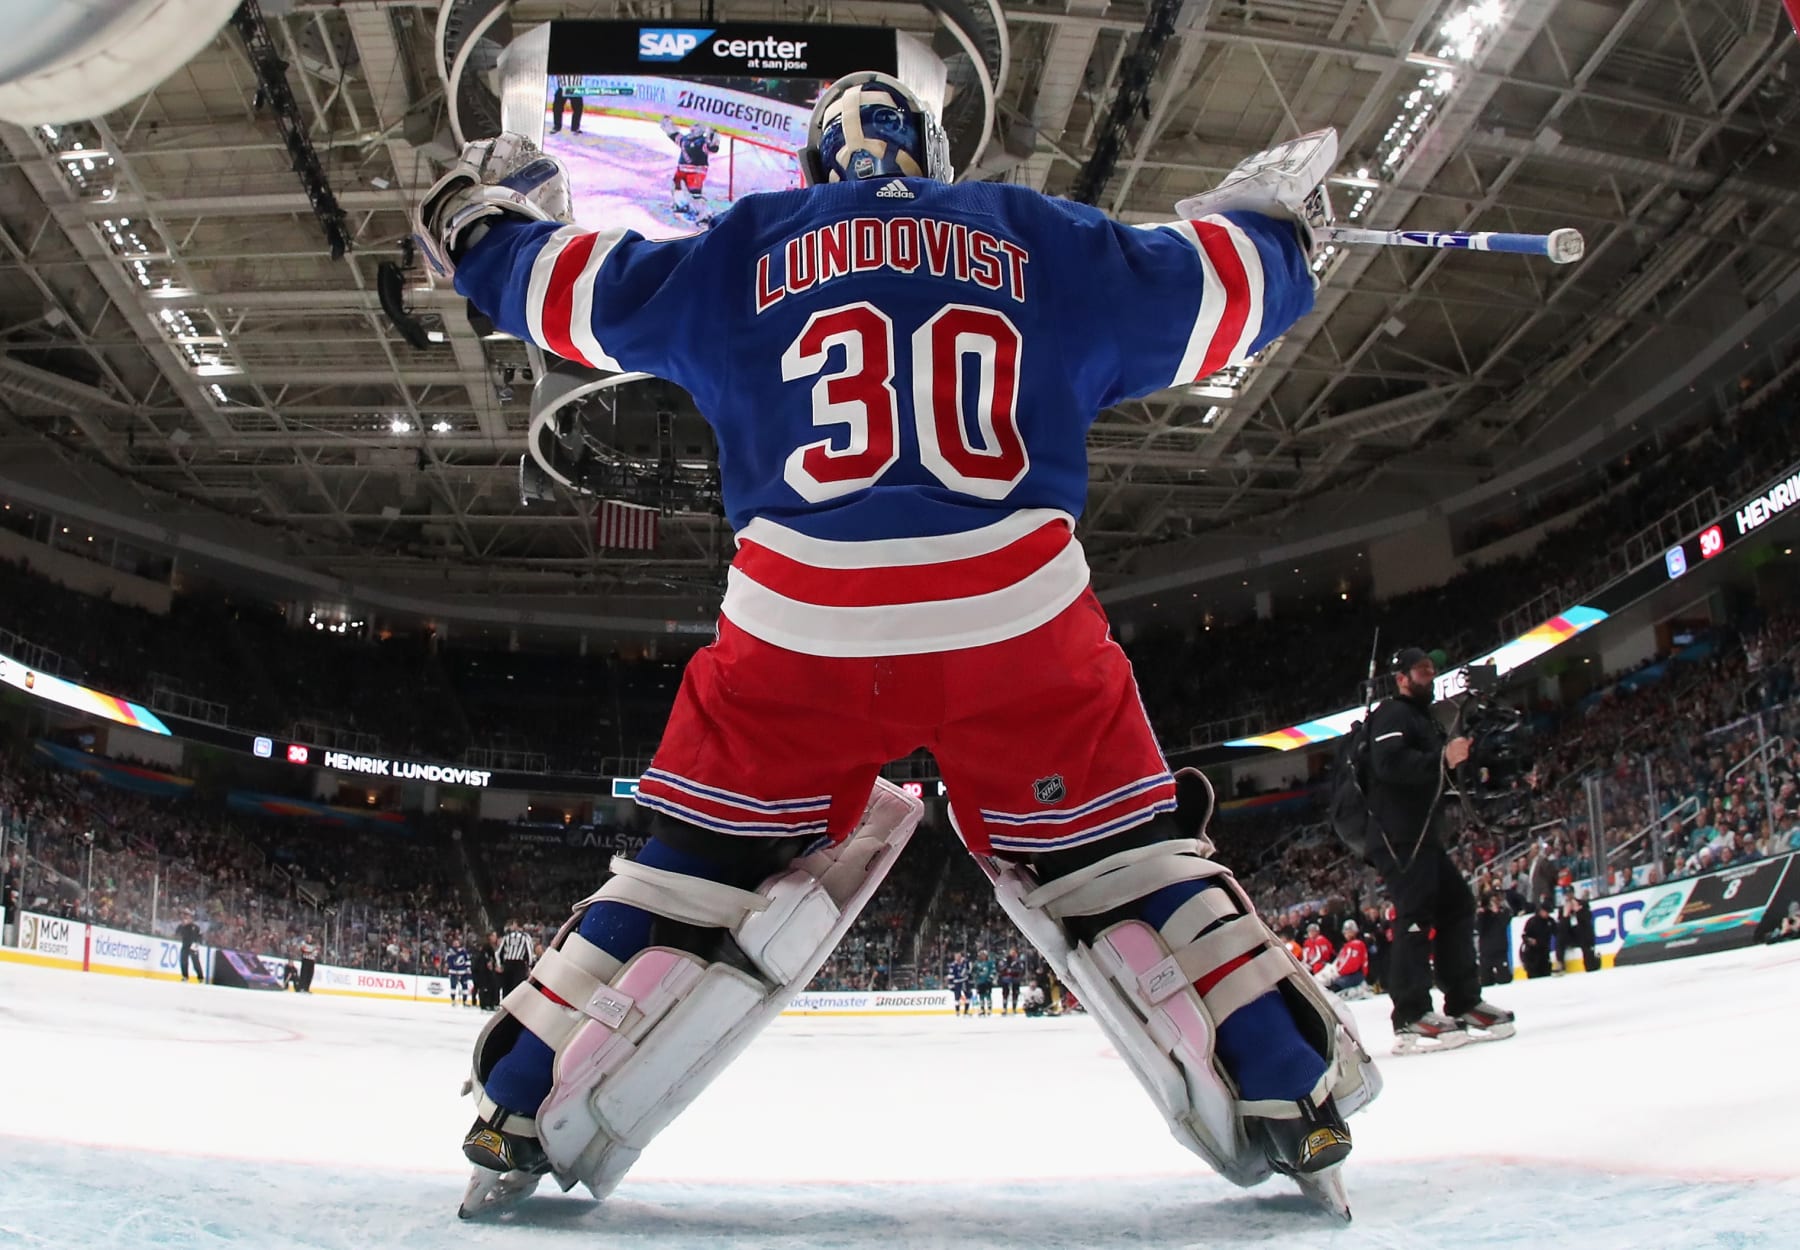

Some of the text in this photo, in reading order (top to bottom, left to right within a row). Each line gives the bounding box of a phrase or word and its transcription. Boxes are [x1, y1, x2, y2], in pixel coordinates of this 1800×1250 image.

[639, 33, 808, 59] SAP center
[747, 58, 808, 71] at san jose
[677, 90, 792, 132] BRIDGESTONE
[876, 190, 915, 199] adidas
[755, 217, 1029, 315] LUNDQVIST
[781, 301, 1030, 504] 30
[1700, 529, 1720, 556] 30
[288, 746, 492, 788] 30 HENRIK LUNDQVIST
[1723, 878, 1742, 900] 8
[40, 919, 70, 943] MGM
[39, 942, 69, 956] RESORTS
[95, 935, 152, 961] ticketmaster
[357, 975, 406, 991] HONDA
[875, 995, 947, 1007] BRIDGESTONE
